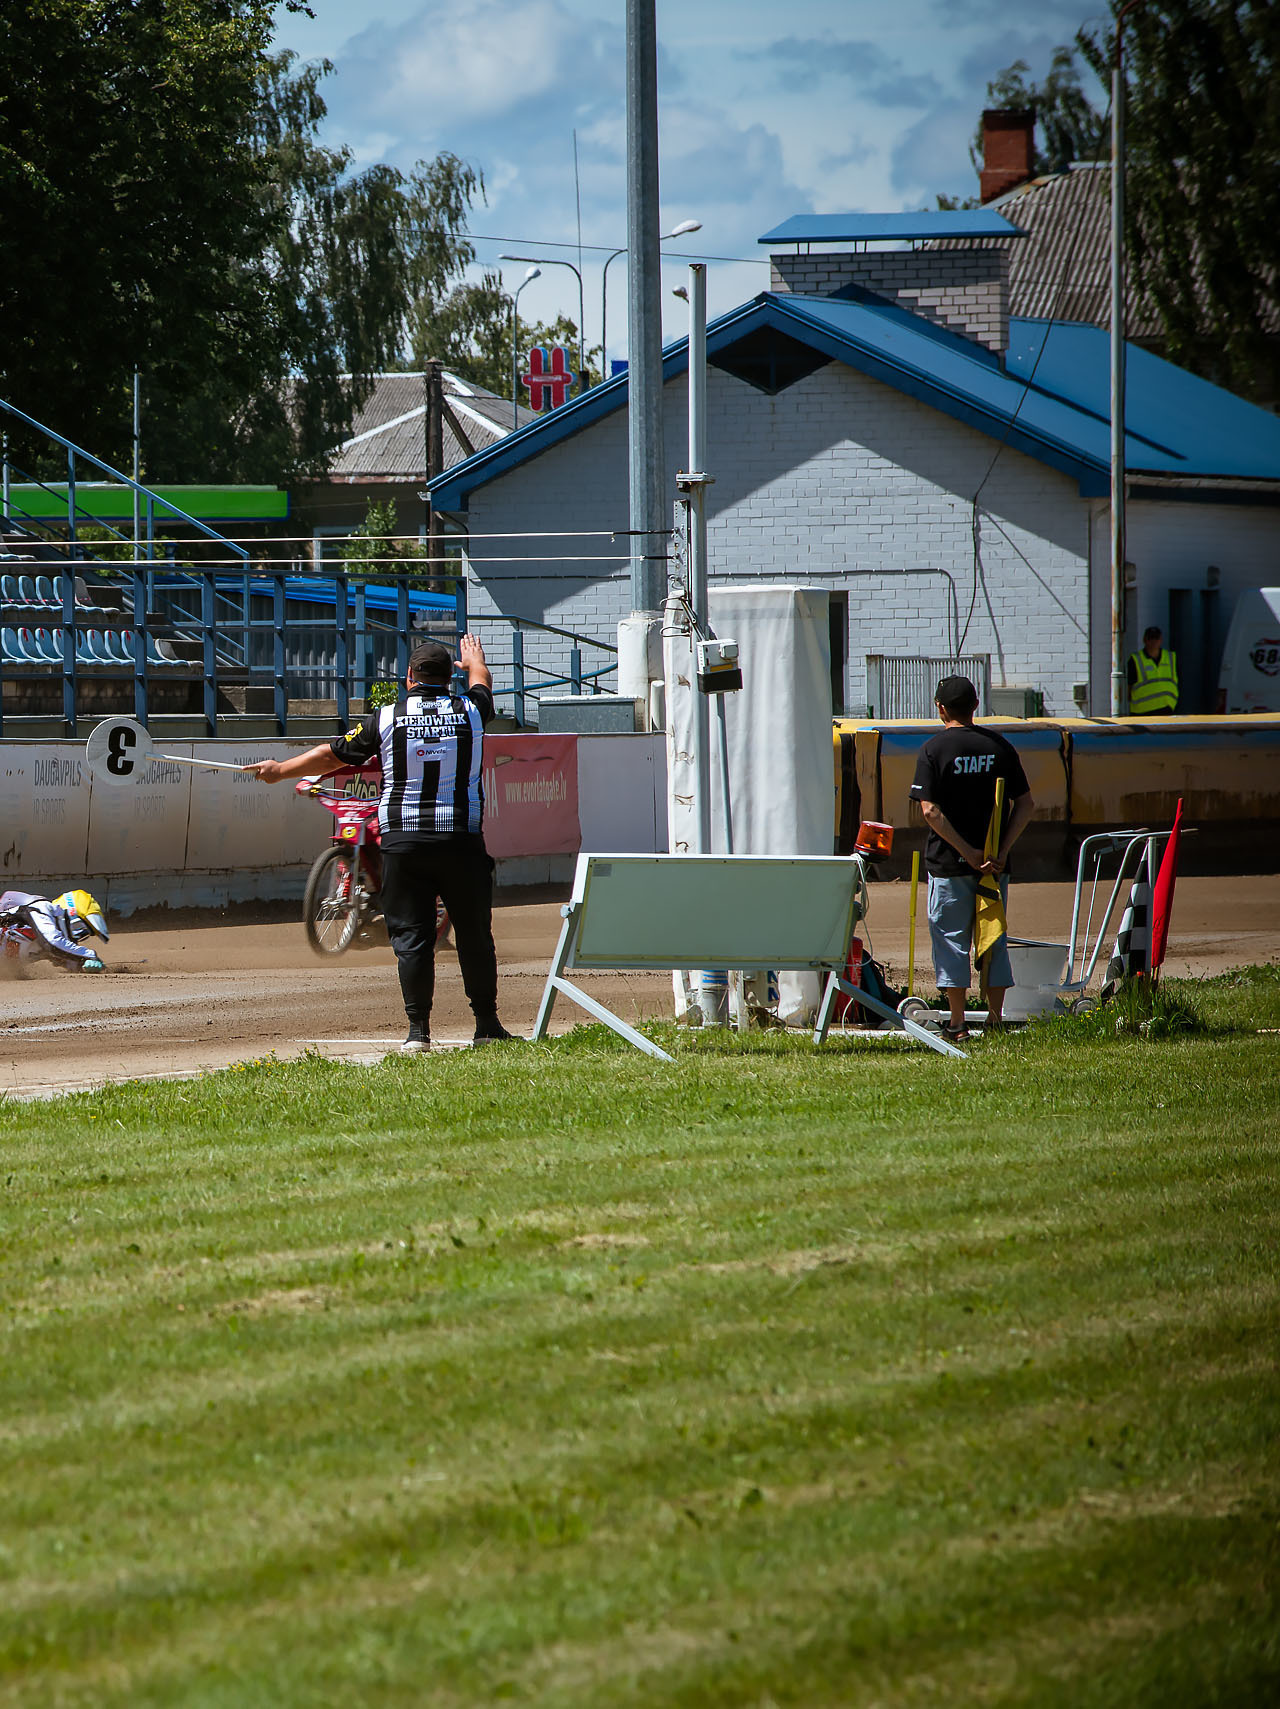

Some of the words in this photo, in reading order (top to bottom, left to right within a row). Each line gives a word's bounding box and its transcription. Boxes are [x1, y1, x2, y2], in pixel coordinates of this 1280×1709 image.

[396, 714, 467, 727] KIEROWNIK
[407, 726, 456, 738] STARTU
[34, 759, 82, 786] DAUGAVPILS
[953, 754, 996, 775] STAFF
